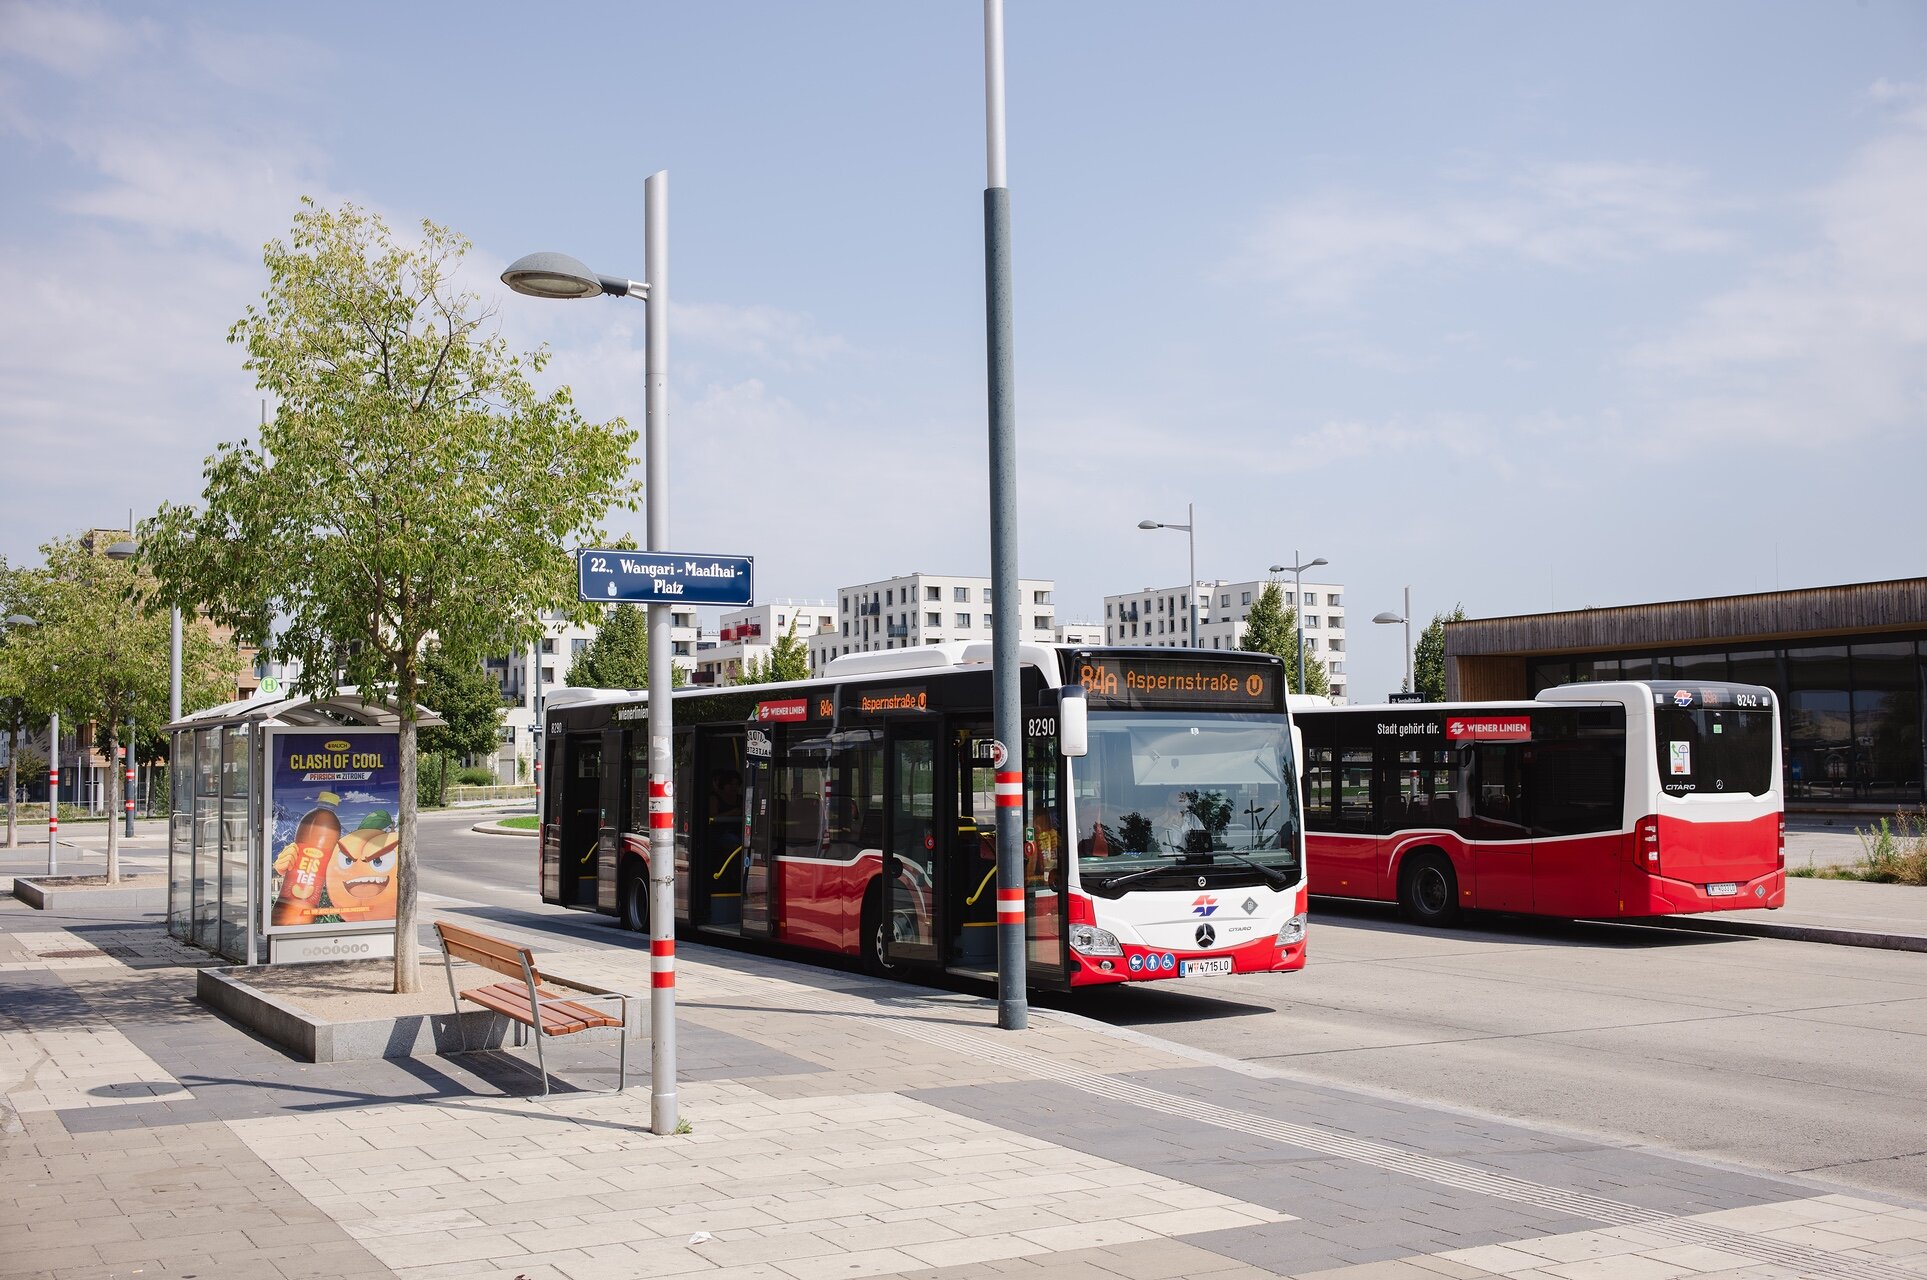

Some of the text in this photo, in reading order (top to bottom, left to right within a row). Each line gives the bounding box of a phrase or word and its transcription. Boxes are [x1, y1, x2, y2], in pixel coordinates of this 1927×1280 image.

[654, 579, 684, 595] Platz
[1080, 664, 1118, 695] 84A
[1127, 671, 1239, 693] Aspernstraße
[862, 695, 916, 712] Aspernstraße
[1737, 694, 1757, 707] 8242
[770, 705, 806, 716] WIENER LINIEN
[551, 722, 563, 734] 8290
[1028, 717, 1055, 737] 8290
[1377, 722, 1440, 737] Stadt gehört dir.
[1467, 723, 1527, 733] WIENER LINIEN
[290, 753, 384, 770] CLASH OF COOL
[341, 772, 365, 780] ZITRONE
[1187, 964, 1194, 974] W
